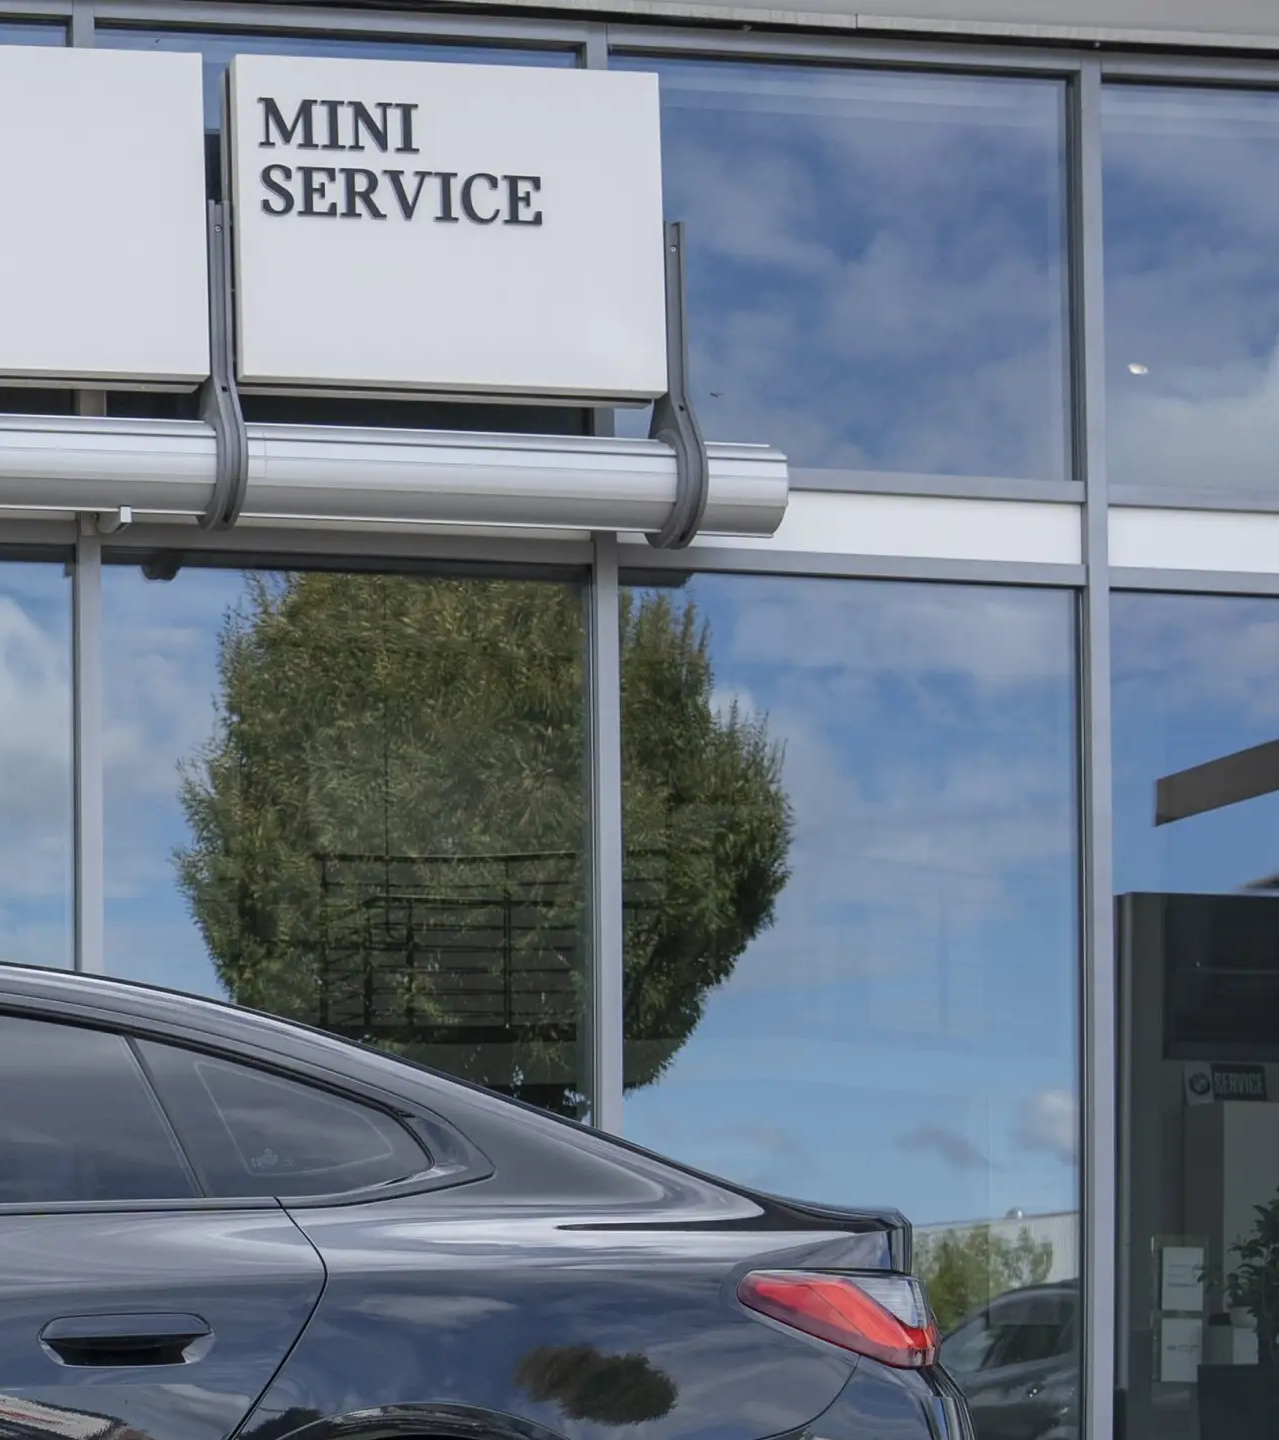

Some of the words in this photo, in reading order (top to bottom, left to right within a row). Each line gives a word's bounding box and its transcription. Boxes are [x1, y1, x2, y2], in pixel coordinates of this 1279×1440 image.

[257, 97, 420, 154] MINI
[260, 164, 543, 226] SERVICE
[1214, 1073, 1263, 1095] SERVICE
